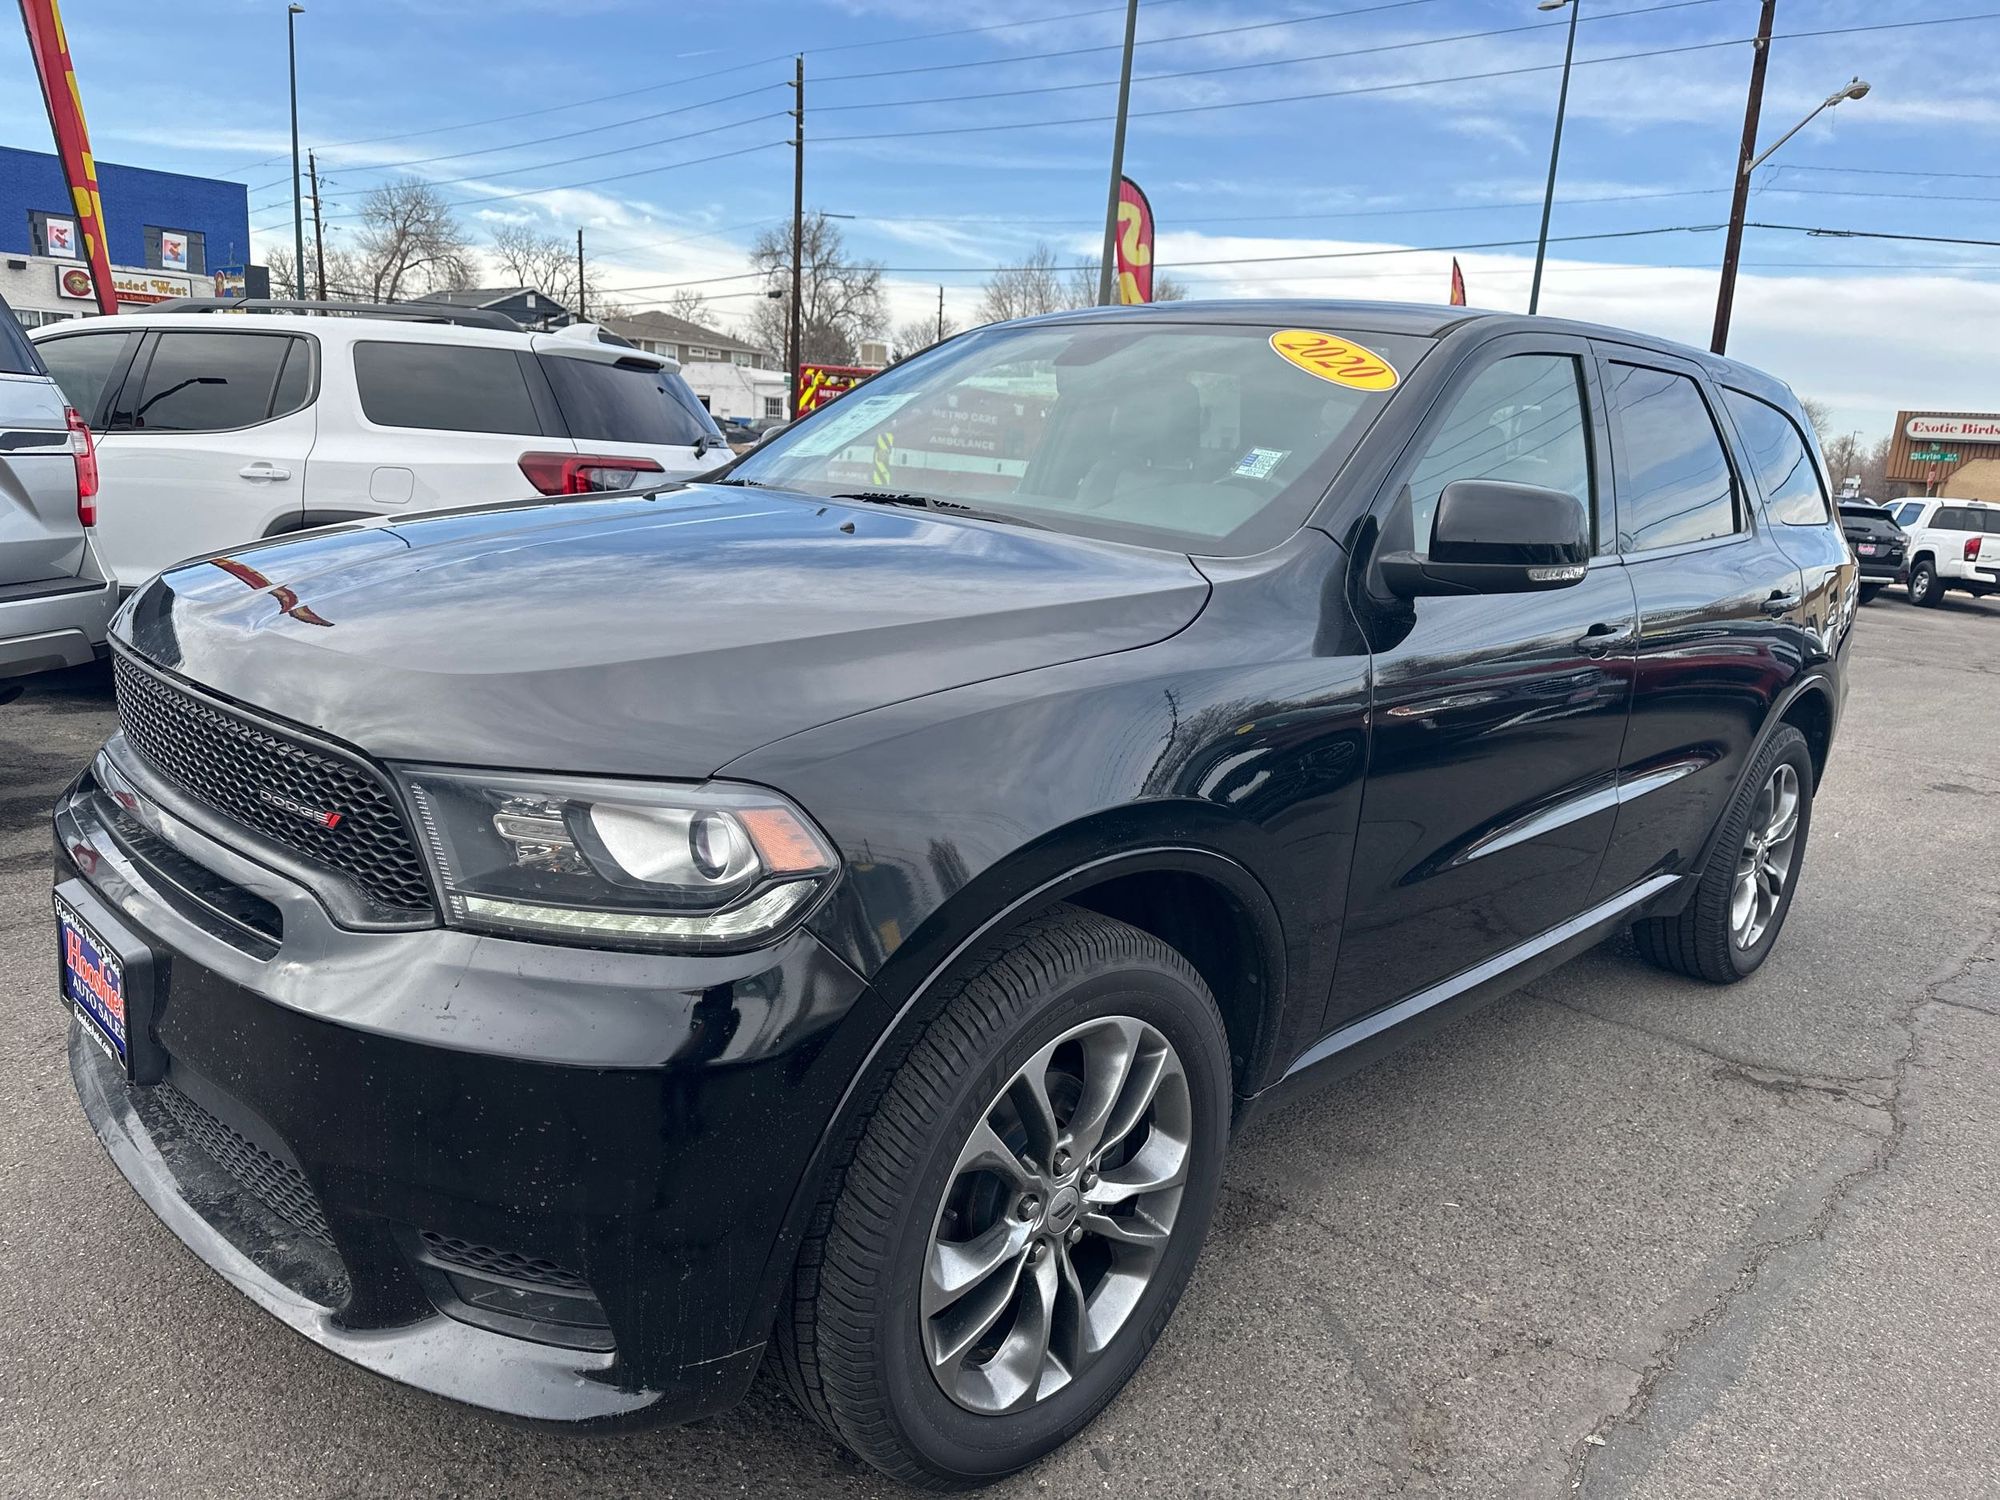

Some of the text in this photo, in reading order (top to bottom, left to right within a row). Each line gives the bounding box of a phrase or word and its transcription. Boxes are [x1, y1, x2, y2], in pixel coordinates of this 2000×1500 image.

[112, 279, 188, 296] eaded West
[1278, 338, 1387, 378] 2020
[818, 388, 843, 399] METR
[931, 408, 999, 425] METRO CARE
[1912, 422, 2000, 435] Exotic Birds
[928, 435, 996, 451] AMBULANCE
[260, 789, 329, 824] DODGE
[72, 975, 126, 1040] AUTO SALES
